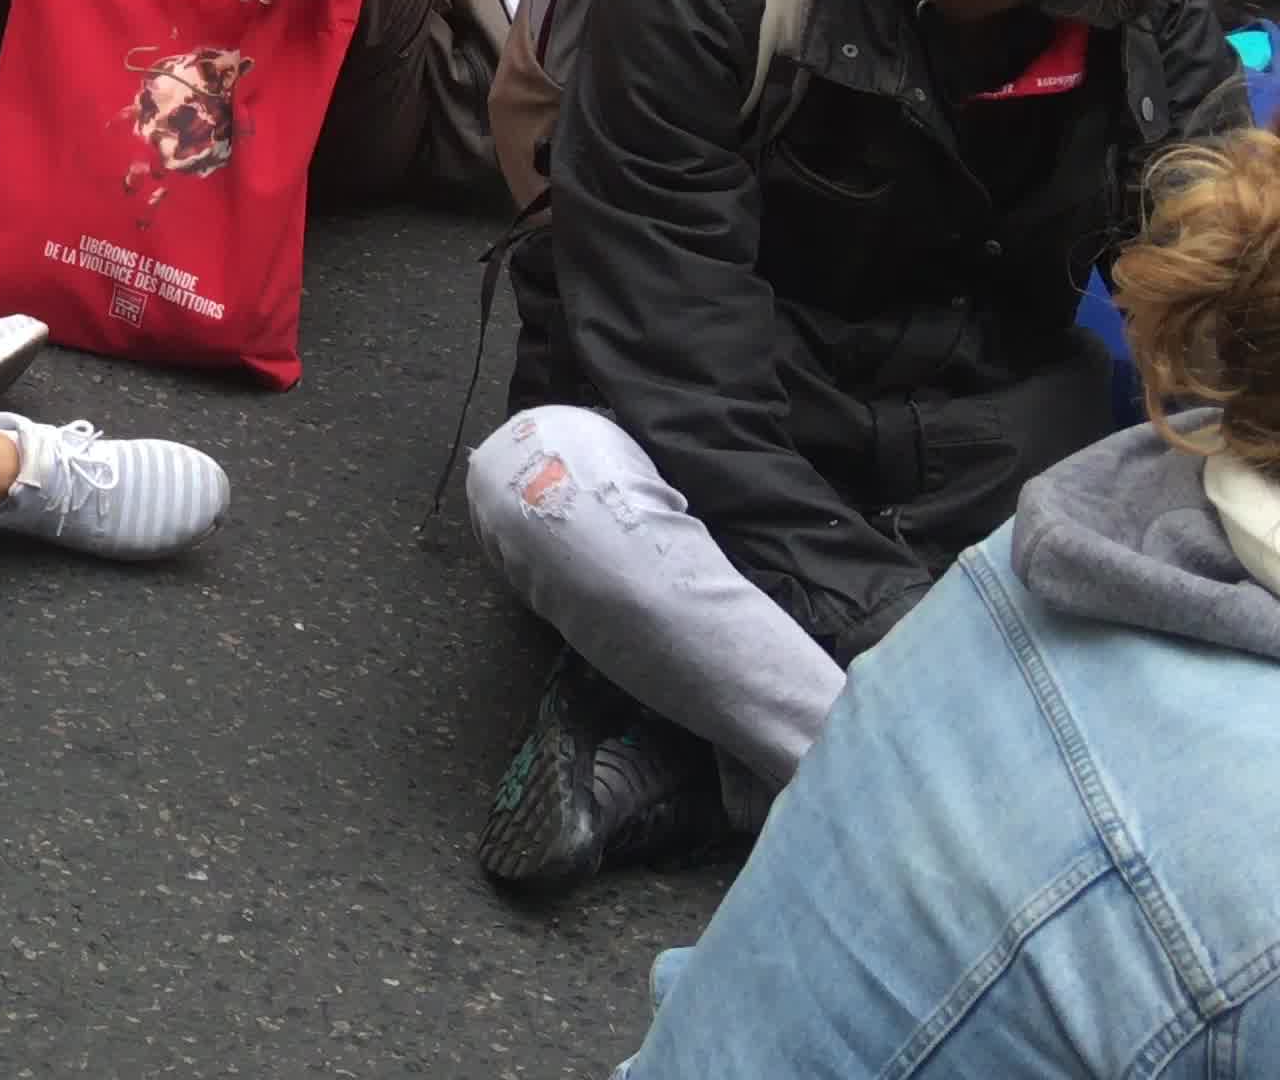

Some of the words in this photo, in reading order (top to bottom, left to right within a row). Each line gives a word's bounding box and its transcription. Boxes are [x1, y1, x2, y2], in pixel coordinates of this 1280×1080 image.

[44, 240, 60, 261] DE
[61, 246, 76, 266] LA
[79, 251, 134, 285] VIOLENCE
[134, 270, 159, 294] DES
[158, 281, 225, 320] ABATTOIRS
[79, 234, 139, 268] LIBÉRONS
[139, 255, 154, 274] LE
[153, 261, 200, 292] MONDE
